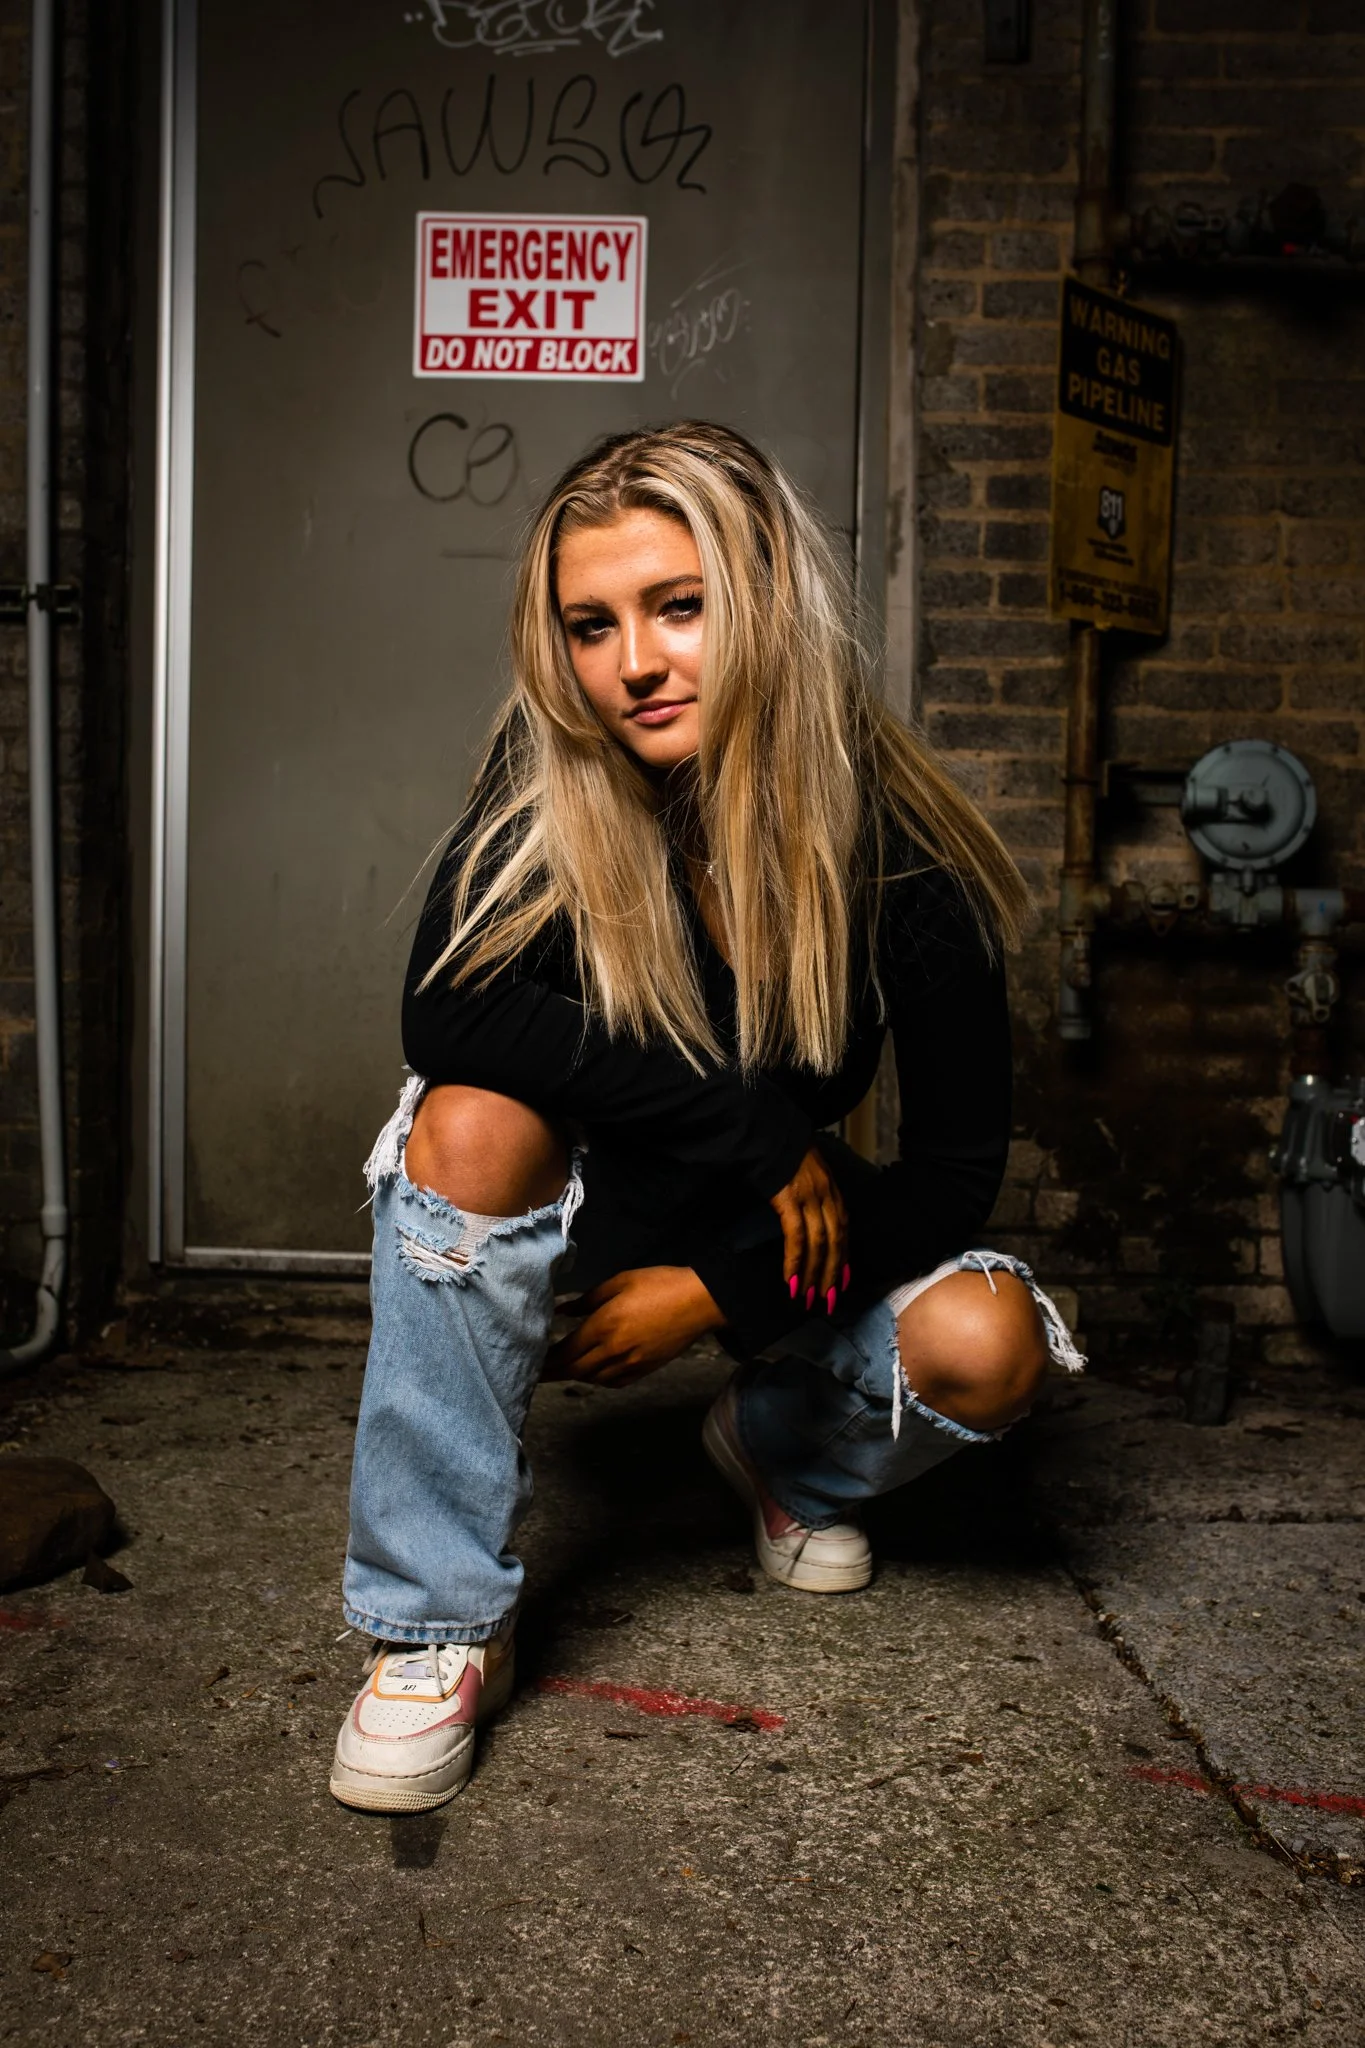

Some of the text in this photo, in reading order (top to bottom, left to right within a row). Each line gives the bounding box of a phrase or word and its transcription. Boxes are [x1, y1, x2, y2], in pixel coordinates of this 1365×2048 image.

[430, 228, 634, 282] EMERGENCY
[468, 289, 596, 330] EXIT
[1070, 294, 1170, 363] WARNING
[425, 337, 634, 372] DO NOT BLOCK
[1097, 347, 1141, 387] GAS
[1068, 372, 1165, 433] PIPELINE
[1101, 489, 1122, 521] 811
